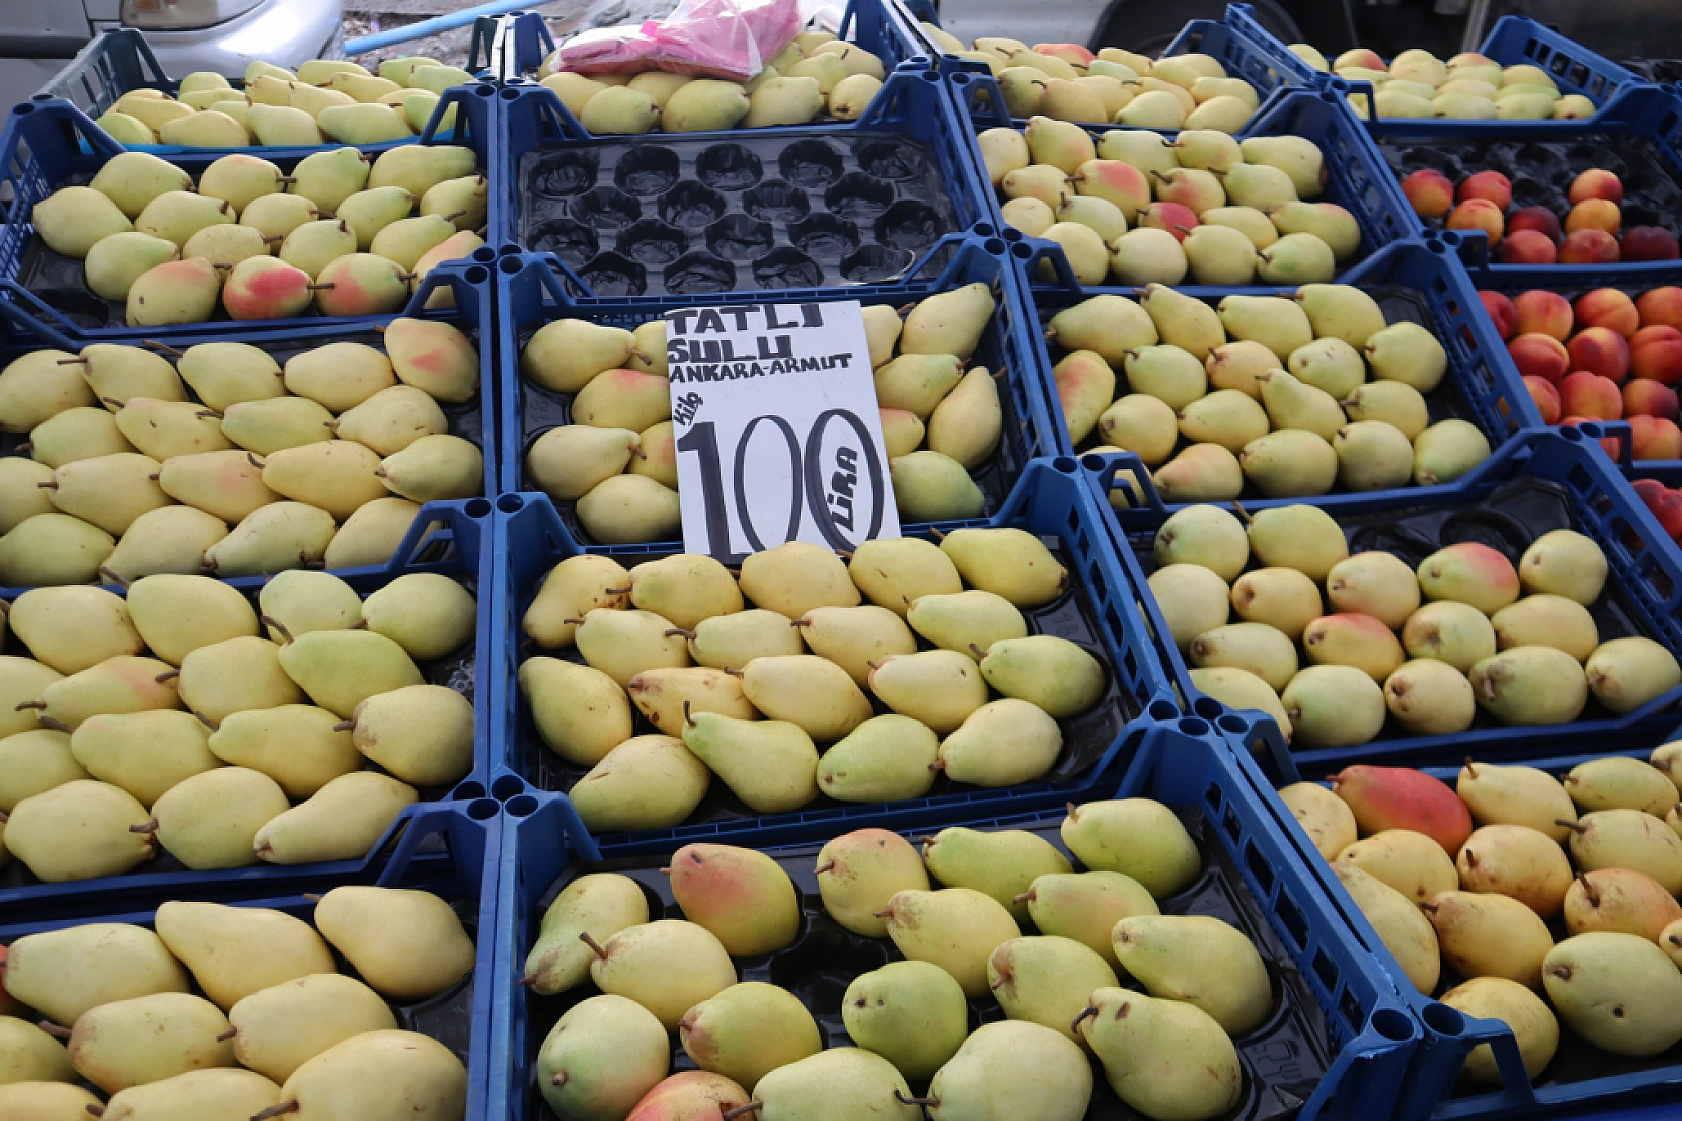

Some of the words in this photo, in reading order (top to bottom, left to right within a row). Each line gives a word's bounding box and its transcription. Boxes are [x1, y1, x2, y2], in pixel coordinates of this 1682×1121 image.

[664, 303, 823, 335] TATLI
[667, 335, 793, 364] SULU
[670, 353, 852, 383] ANKARA-ARMUT
[677, 408, 884, 564] 100
